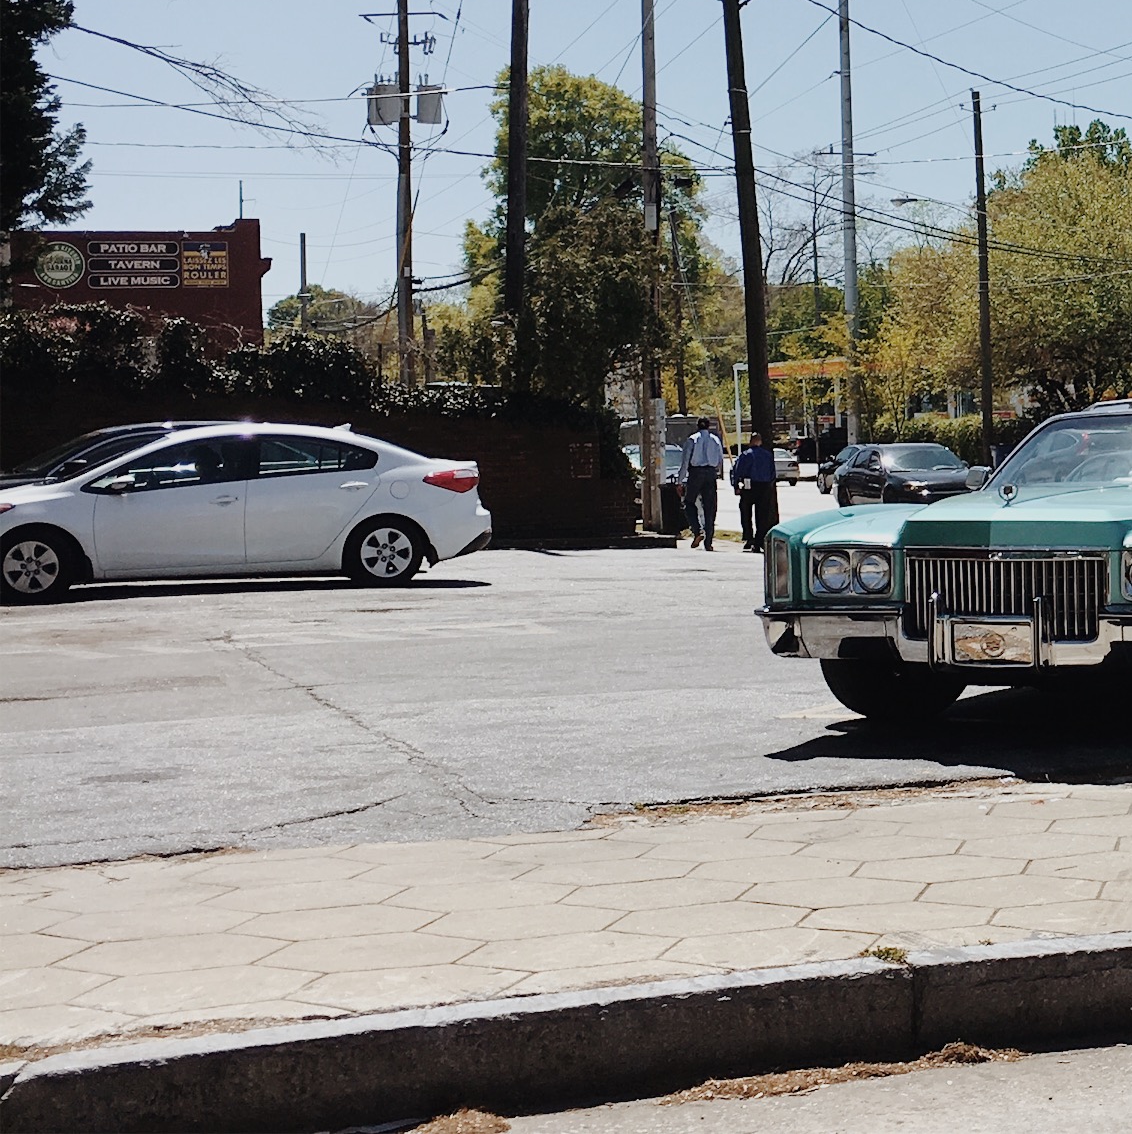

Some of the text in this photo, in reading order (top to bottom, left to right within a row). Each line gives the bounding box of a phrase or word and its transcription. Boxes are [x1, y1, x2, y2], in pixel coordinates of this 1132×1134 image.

[100, 244, 167, 253] PATIO BAR
[108, 260, 160, 269] TAVERN
[183, 271, 227, 279] ROULER
[100, 276, 171, 285] LIVE MUSIC
